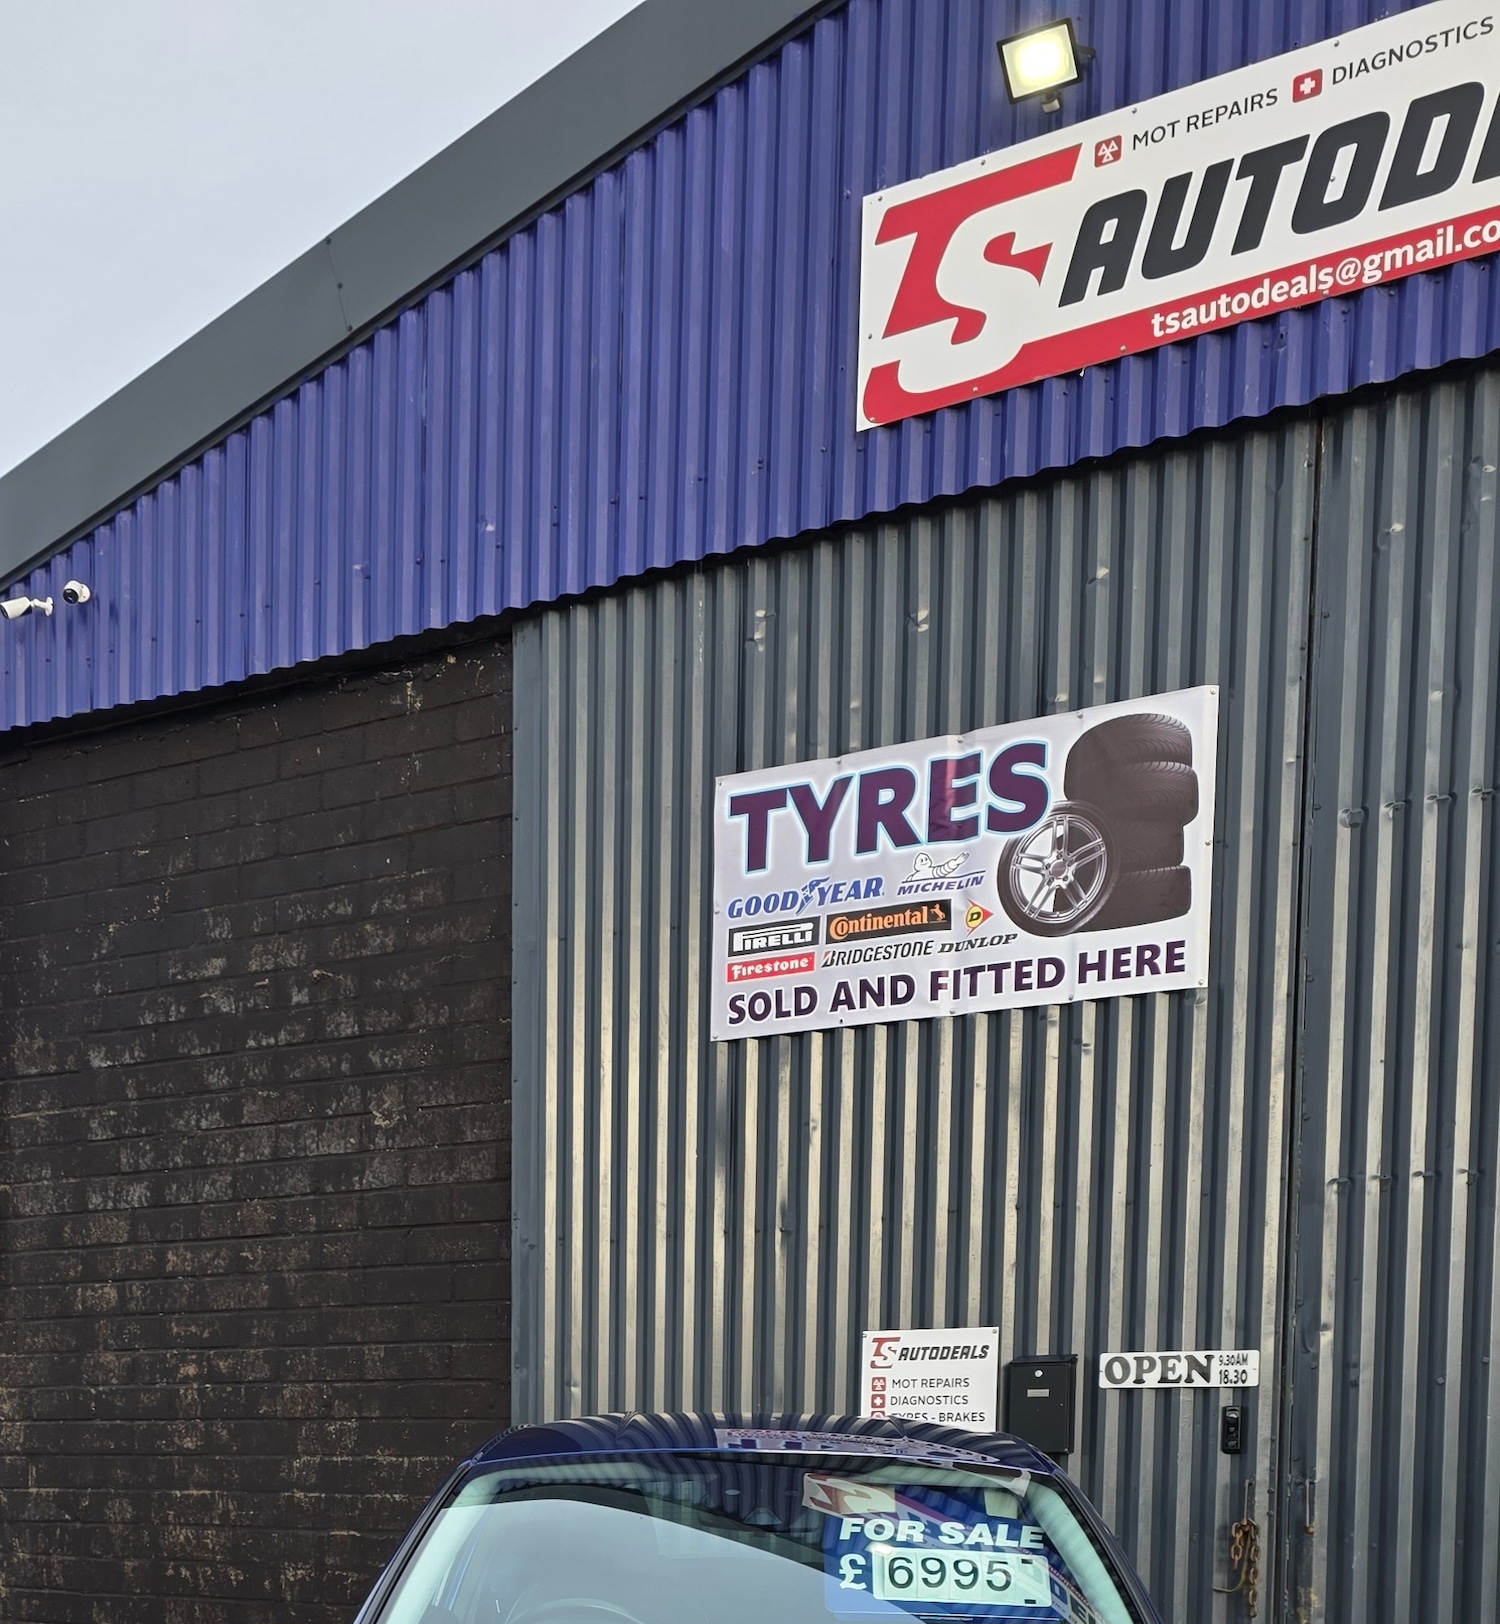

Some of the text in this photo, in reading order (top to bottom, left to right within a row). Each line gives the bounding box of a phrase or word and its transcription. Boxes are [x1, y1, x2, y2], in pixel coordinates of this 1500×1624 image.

[1331, 16, 1494, 85] DIAGNOSTICS
[1132, 87, 1278, 151] MOT REPAIRS
[729, 741, 1049, 872] TYRES
[897, 874, 985, 896] MICHELIN
[733, 921, 814, 951] PIRELLI
[828, 905, 929, 940] Continental
[821, 940, 935, 968] BRIDGESTONE
[937, 933, 1019, 954] DUNLOP
[728, 940, 1187, 1025] SOLD AND FITTED HERE
[731, 957, 809, 979] Firestone
[898, 1344, 990, 1361] AUTODEALS
[891, 1377, 970, 1389] MOT REPAIRS
[1104, 1354, 1215, 1385] OPEN
[1218, 1369, 1248, 1385] 18.30
[890, 1395, 969, 1406] DIAGNOSTICS
[938, 1412, 986, 1422] BRAKES
[838, 1517, 1045, 1550] FOR SALE
[887, 1556, 1012, 1592] 6995
